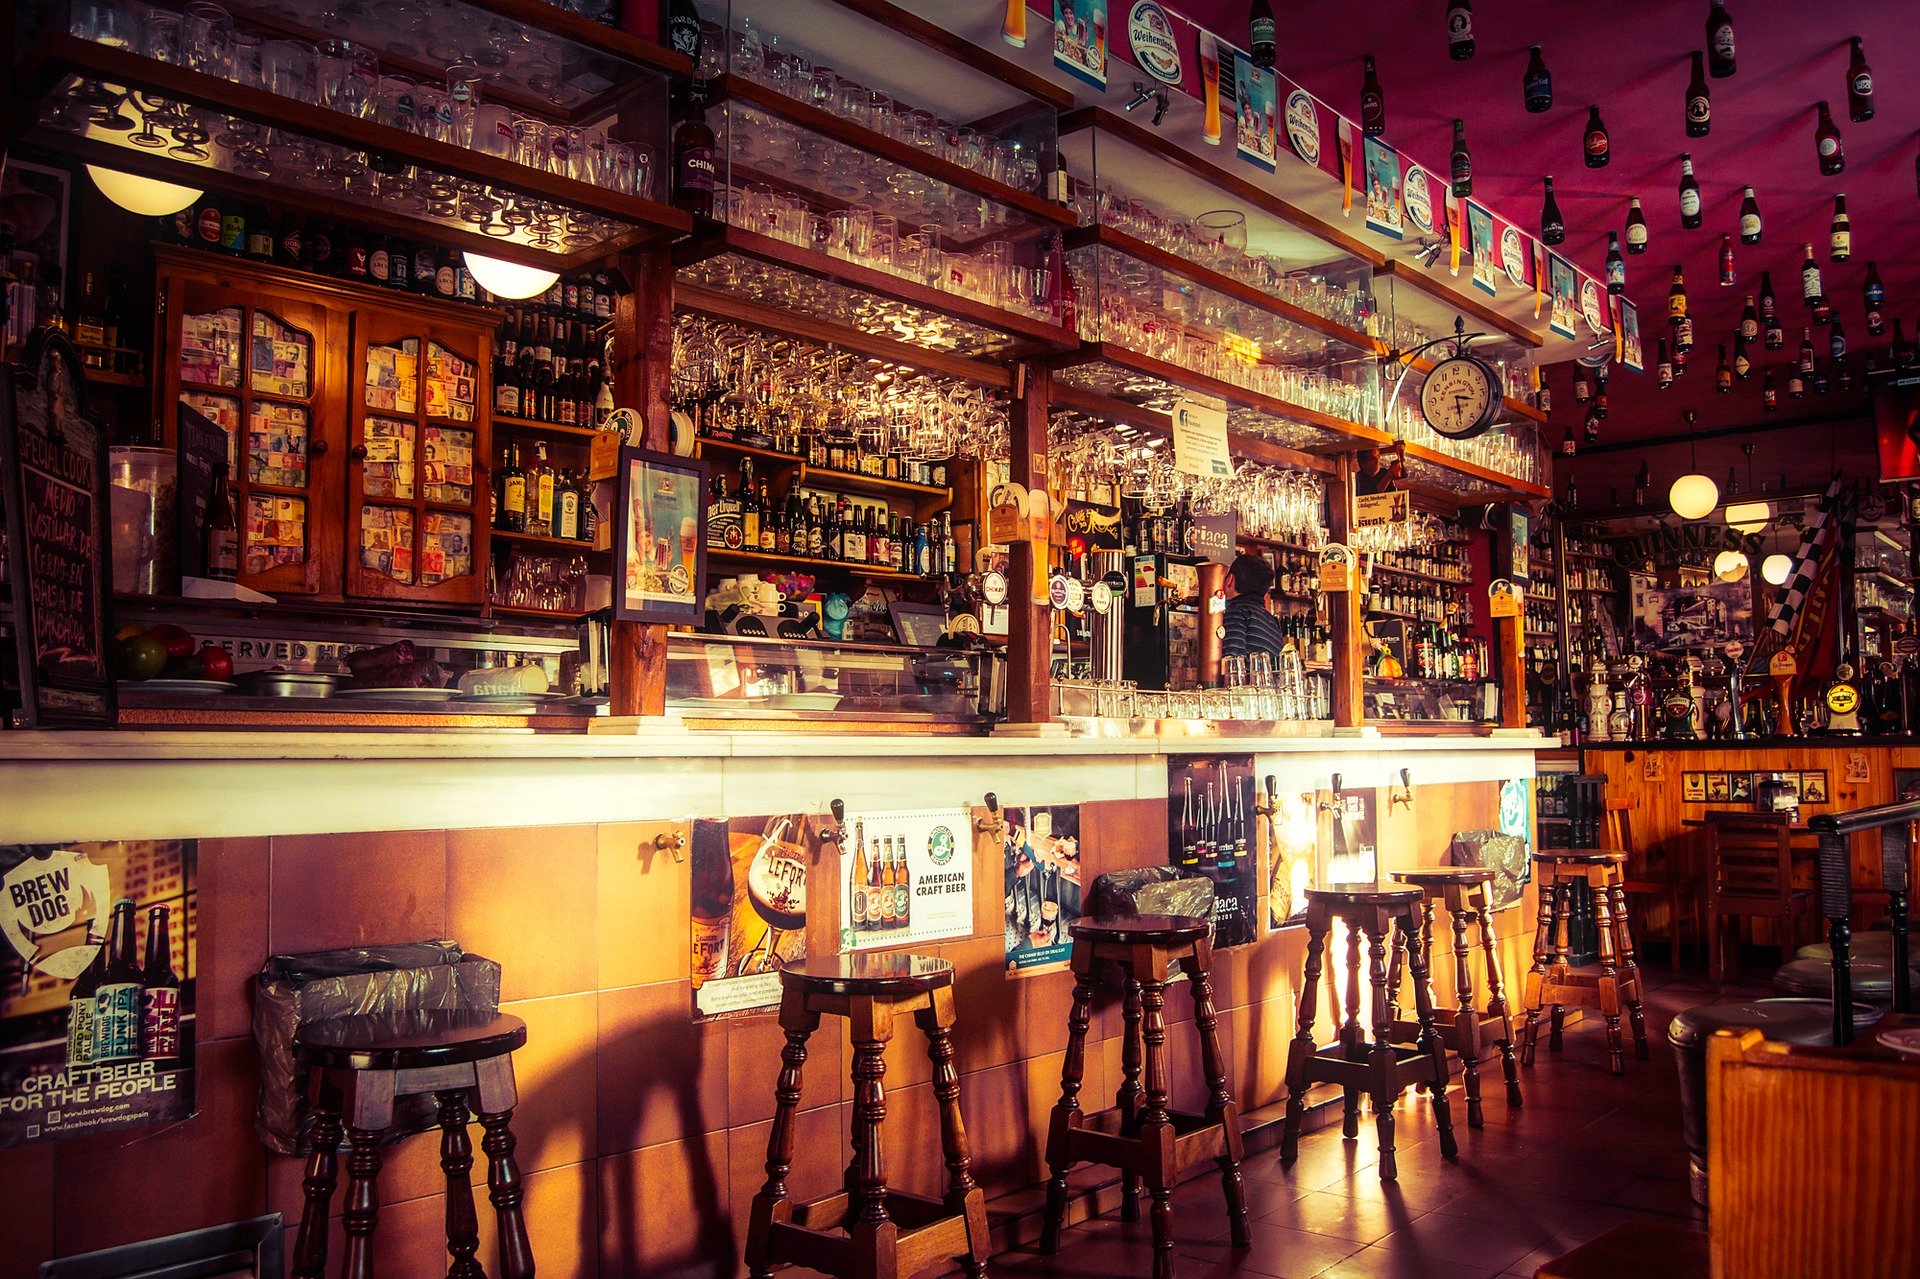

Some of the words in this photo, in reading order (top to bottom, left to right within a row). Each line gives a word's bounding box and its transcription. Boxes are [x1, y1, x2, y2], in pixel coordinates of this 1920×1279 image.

[1440, 379, 1475, 401] KENSINGTON
[19, 427, 60, 475] SPECIAL
[63, 449, 91, 488] COOK
[720, 500, 742, 513] Urquell
[29, 502, 78, 553] COSTILLAR
[1195, 525, 1228, 549] riaca
[1613, 525, 1767, 569] GUINNESS
[34, 577, 67, 612] SALSA
[9, 867, 70, 908] BREW
[916, 885, 942, 896] CRAFT
[946, 883, 966, 894] BEER
[918, 872, 965, 885] AMERICAN
[28, 894, 70, 927] DOG
[1214, 895, 1239, 913] iaca
[693, 938, 725, 955] EFORT
[117, 987, 129, 1011] IPA
[77, 1001, 86, 1031] PONY
[86, 1012, 94, 1031] ALE
[75, 1032, 84, 1061] DEAD
[83, 1034, 92, 1061] PALE
[101, 1015, 111, 1058] BREWDOG
[115, 1013, 127, 1056] PUNK
[22, 1069, 97, 1093] CRAFT
[100, 1061, 155, 1081] BEER
[0, 1092, 43, 1114] FOR
[46, 1086, 91, 1106] THE
[94, 1074, 176, 1100] PEOPLE
[44, 1111, 149, 1133] www.facebook/brewdogspain
[63, 1103, 131, 1118] www.brewdog.com
